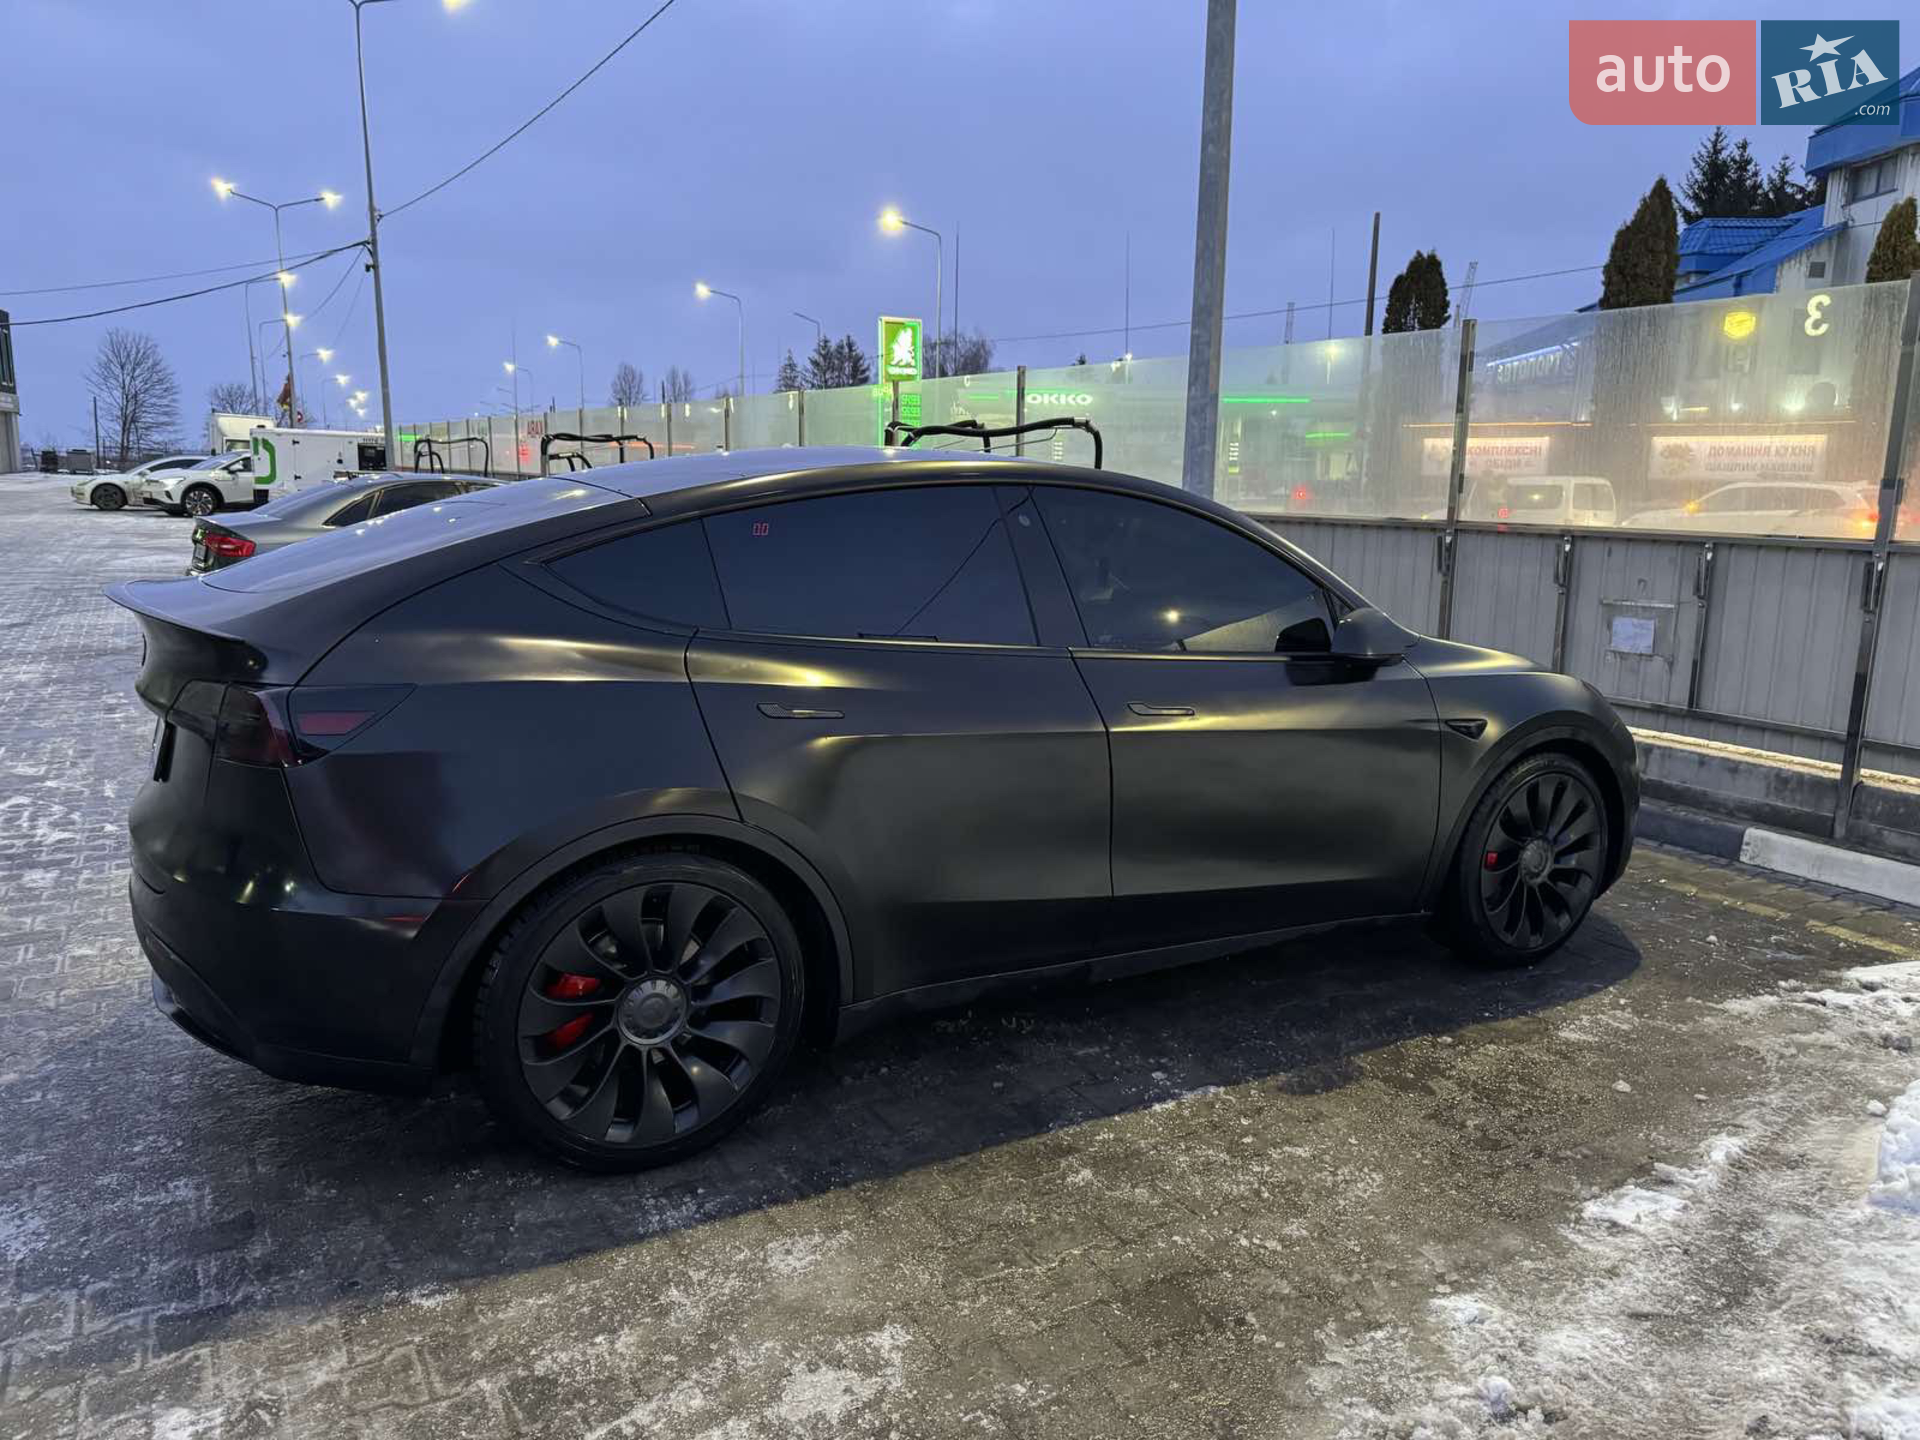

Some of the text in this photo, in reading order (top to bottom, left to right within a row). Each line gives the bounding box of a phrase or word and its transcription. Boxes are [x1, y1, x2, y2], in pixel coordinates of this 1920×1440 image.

[1026, 393, 1093, 405] OKKO
[1708, 444, 1814, 458] ДОМАШНЯ КУХНЯ
